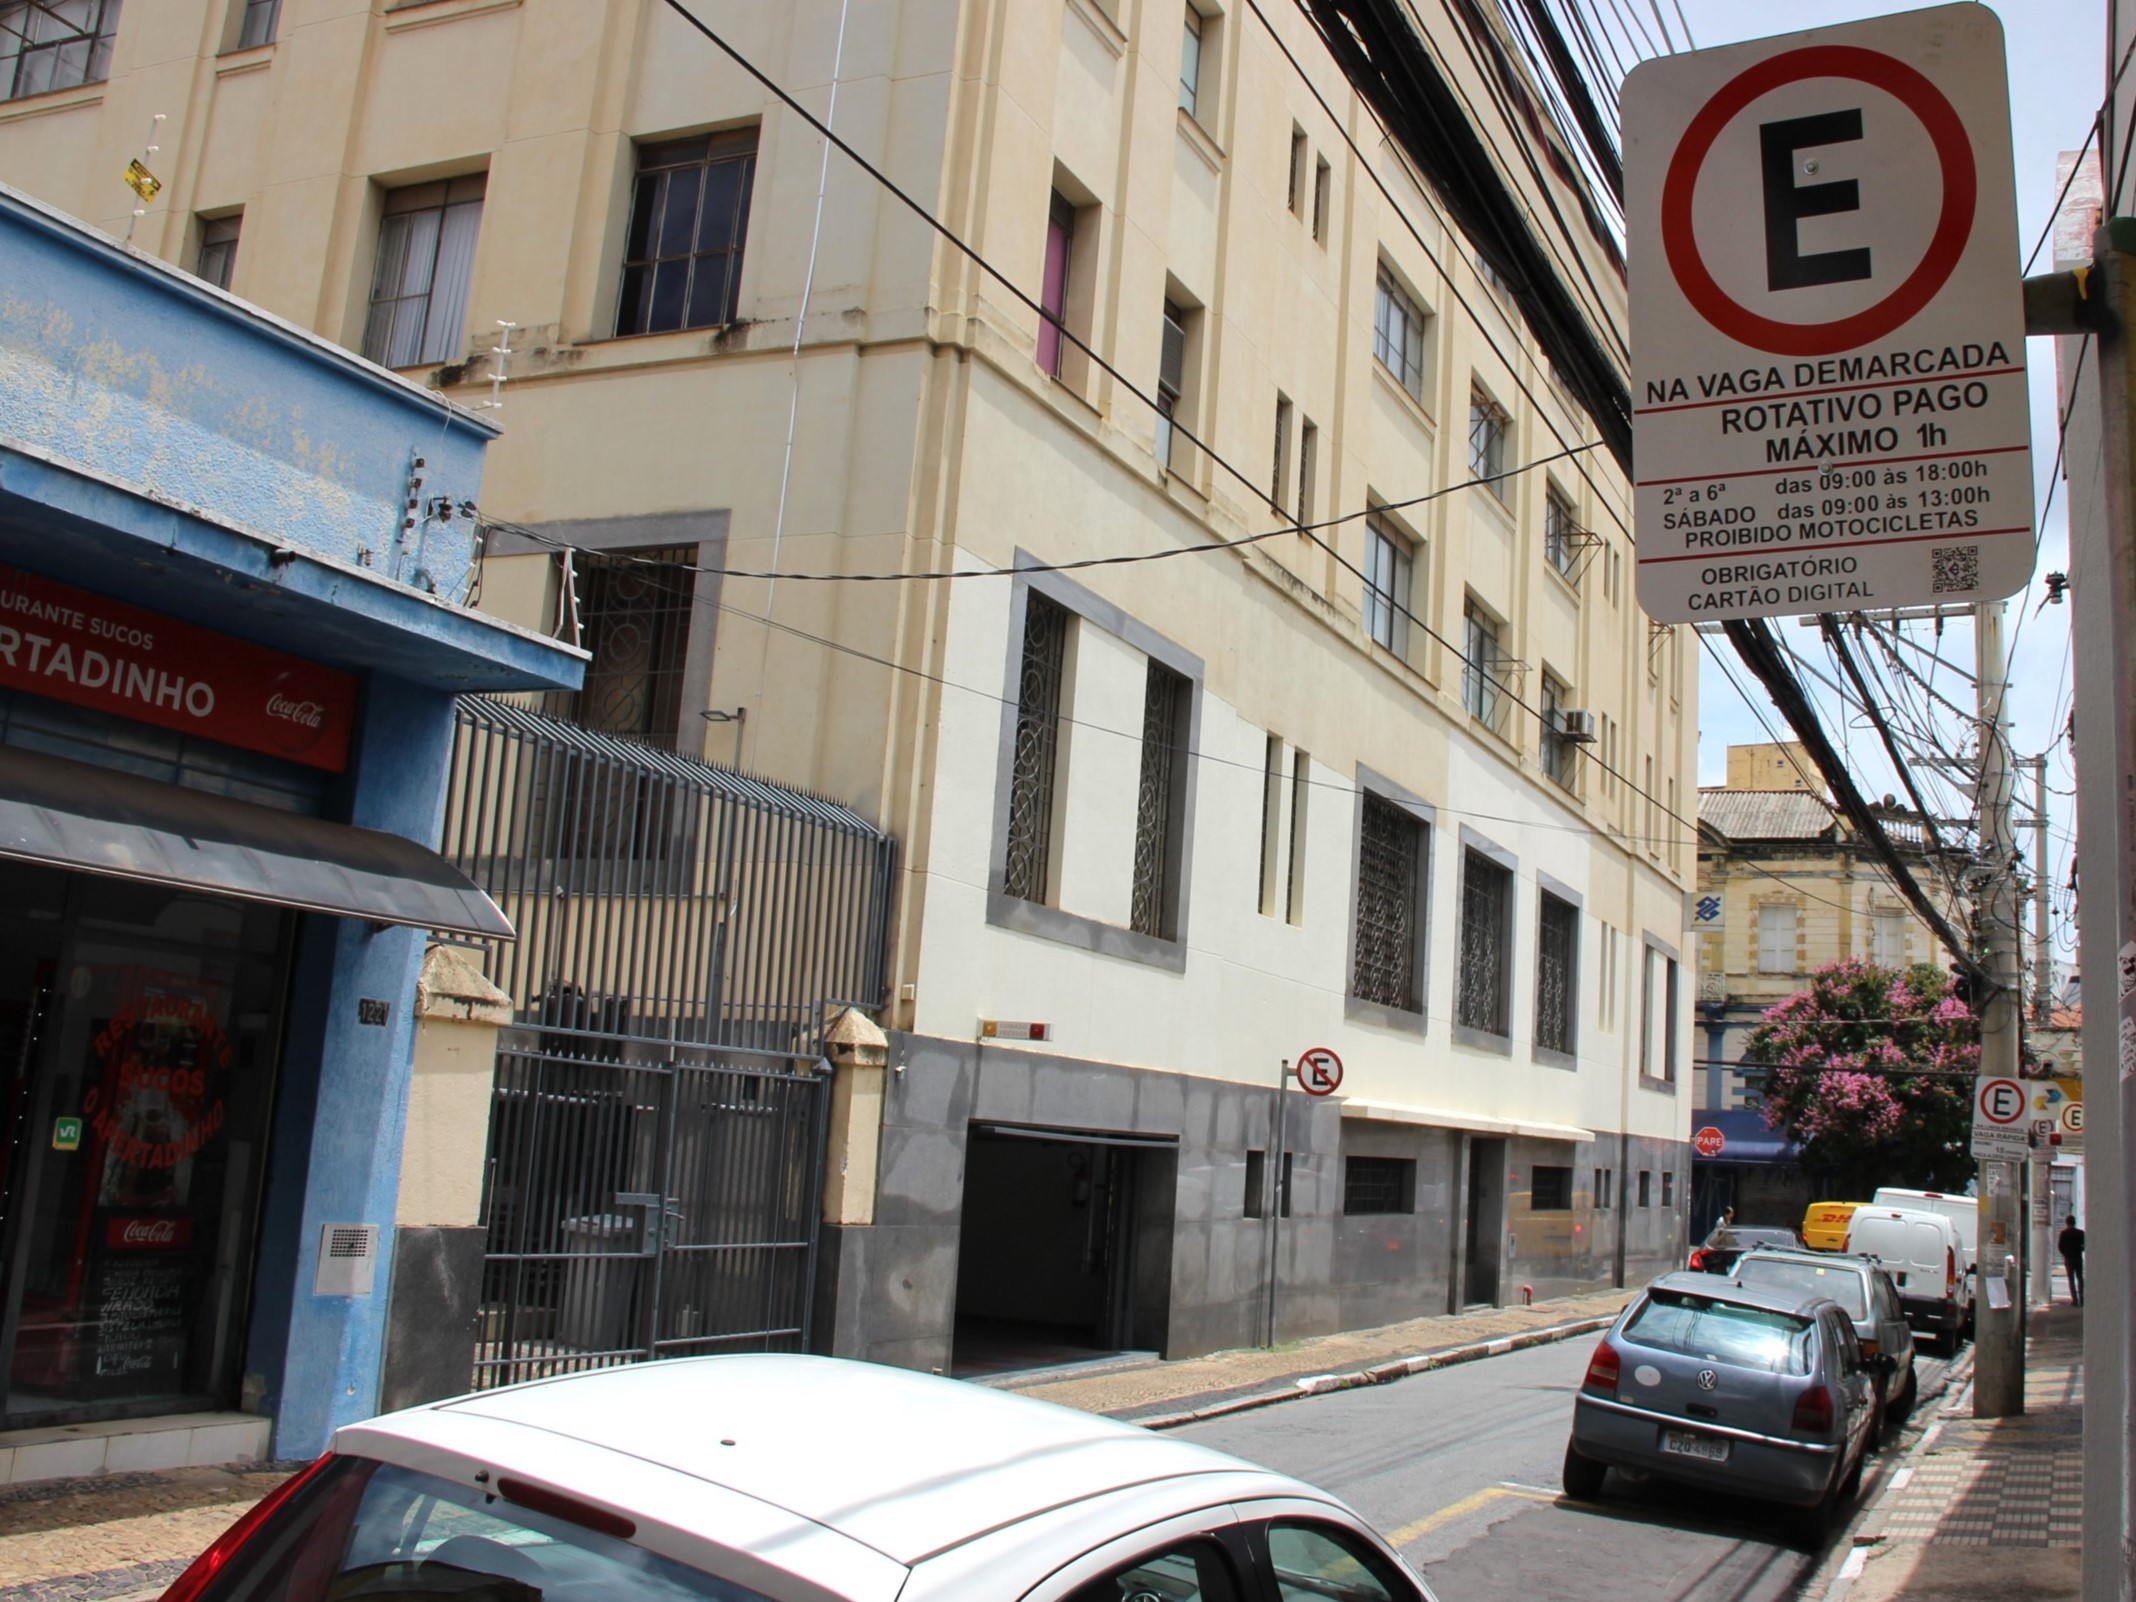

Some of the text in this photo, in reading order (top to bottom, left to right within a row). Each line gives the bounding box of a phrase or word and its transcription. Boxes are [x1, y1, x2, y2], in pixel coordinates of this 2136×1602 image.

[1759, 107, 1872, 292] E
[1647, 341, 2010, 404] NA VAGA DEMARCADA
[1722, 381, 1988, 435] ROTATIVO PAGO
[1766, 422, 1947, 463] MÁXIMO 1h
[1689, 489, 1700, 502] a
[1775, 477, 1812, 494] das
[1819, 470, 1876, 491] 09:00
[1883, 468, 1908, 485] às
[1915, 460, 1988, 482] 18:00h
[1663, 486, 1990, 530] SÁBADO das 09:00 às 13:00h
[1685, 509, 1979, 549] PROIBIDO MOTOCICLETAS
[1701, 555, 1858, 586] OBRIGATÓRIO
[1688, 581, 1875, 611] CARTÃO DIGITAL
[89, 617, 155, 651] SUCOS
[119, 1062, 205, 1095] SUCOS
[1993, 1088, 2012, 1116] E
[2071, 1109, 2081, 1126] E
[1697, 1136, 1722, 1147] PARE
[1821, 1213, 1852, 1223] DH
